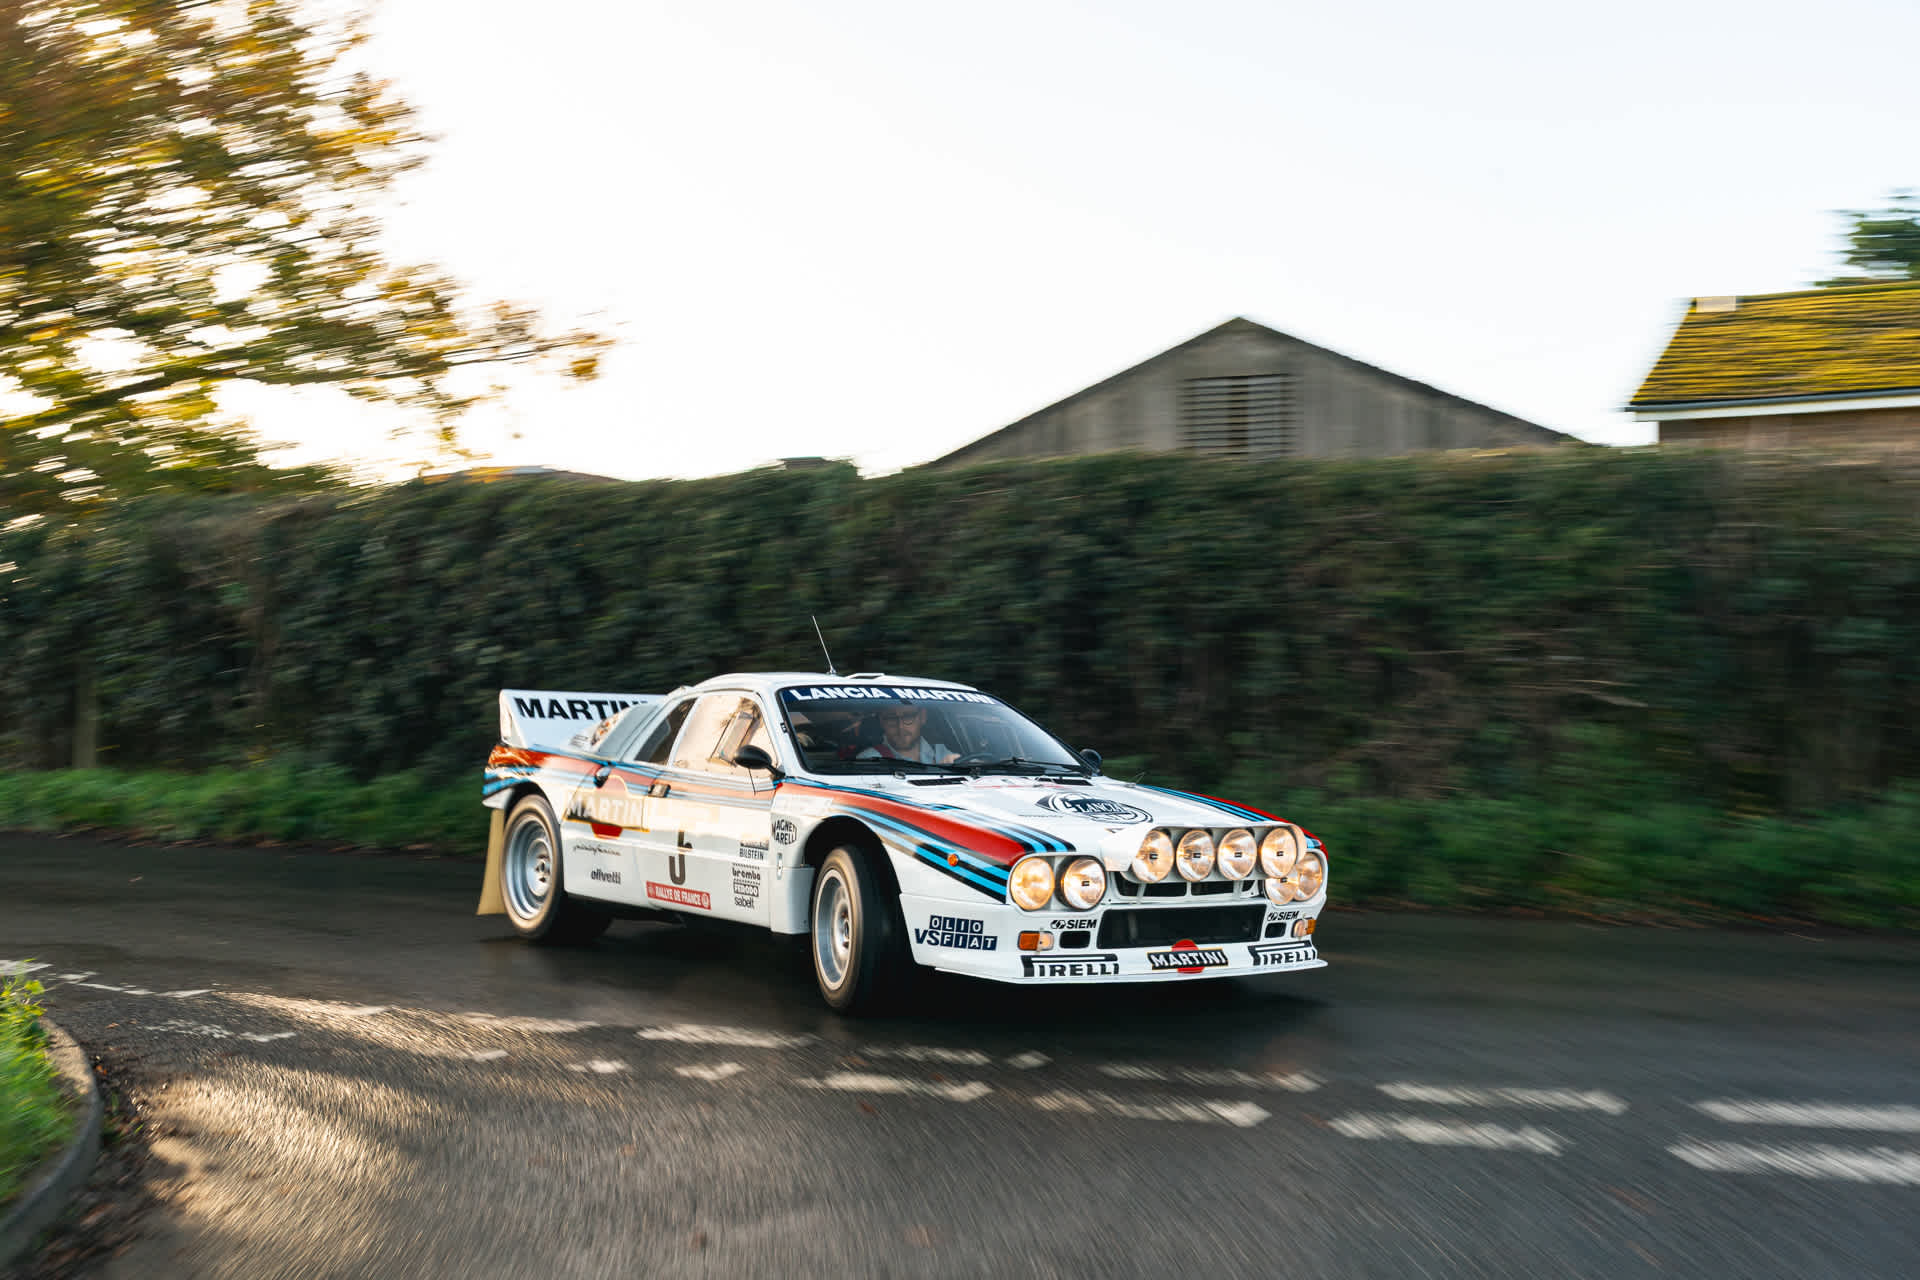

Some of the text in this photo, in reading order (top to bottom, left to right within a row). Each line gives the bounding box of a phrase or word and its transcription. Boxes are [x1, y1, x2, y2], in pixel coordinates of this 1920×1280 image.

[789, 687, 996, 705] LANCIA MARTINI
[513, 696, 648, 720] MARTIN
[739, 847, 764, 861] BILSTEIN
[591, 867, 621, 885] olivetti
[732, 867, 760, 880] brembo
[734, 895, 755, 909] sabelt
[930, 915, 983, 934] OLIO
[1066, 919, 1097, 929] SIEM
[1278, 911, 1299, 921] SIEM
[1150, 951, 1226, 968] MARTINI
[1248, 940, 1317, 966] PIRELLI
[1020, 953, 1119, 978] PIRELLI
